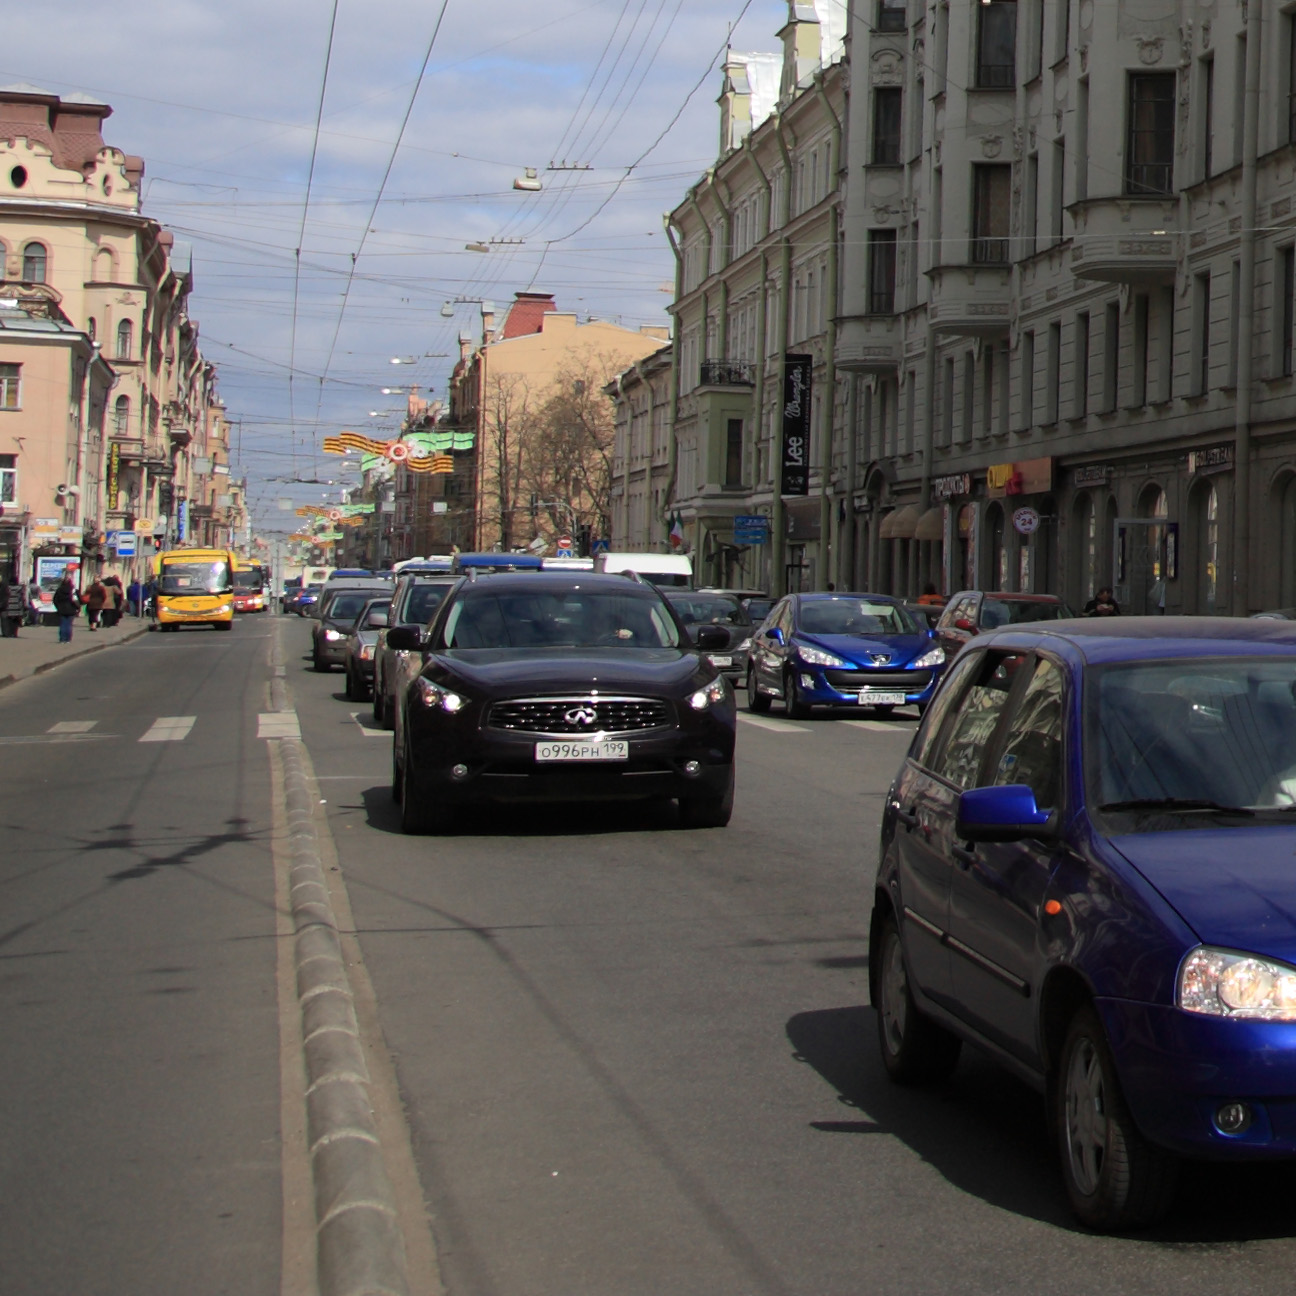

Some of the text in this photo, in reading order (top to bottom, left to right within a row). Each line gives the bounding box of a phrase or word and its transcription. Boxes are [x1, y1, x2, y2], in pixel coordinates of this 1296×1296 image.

[784, 365, 806, 418] Wrangler
[785, 436, 804, 466] Lee
[1021, 518, 1033, 526] 24
[603, 743, 624, 753] 199
